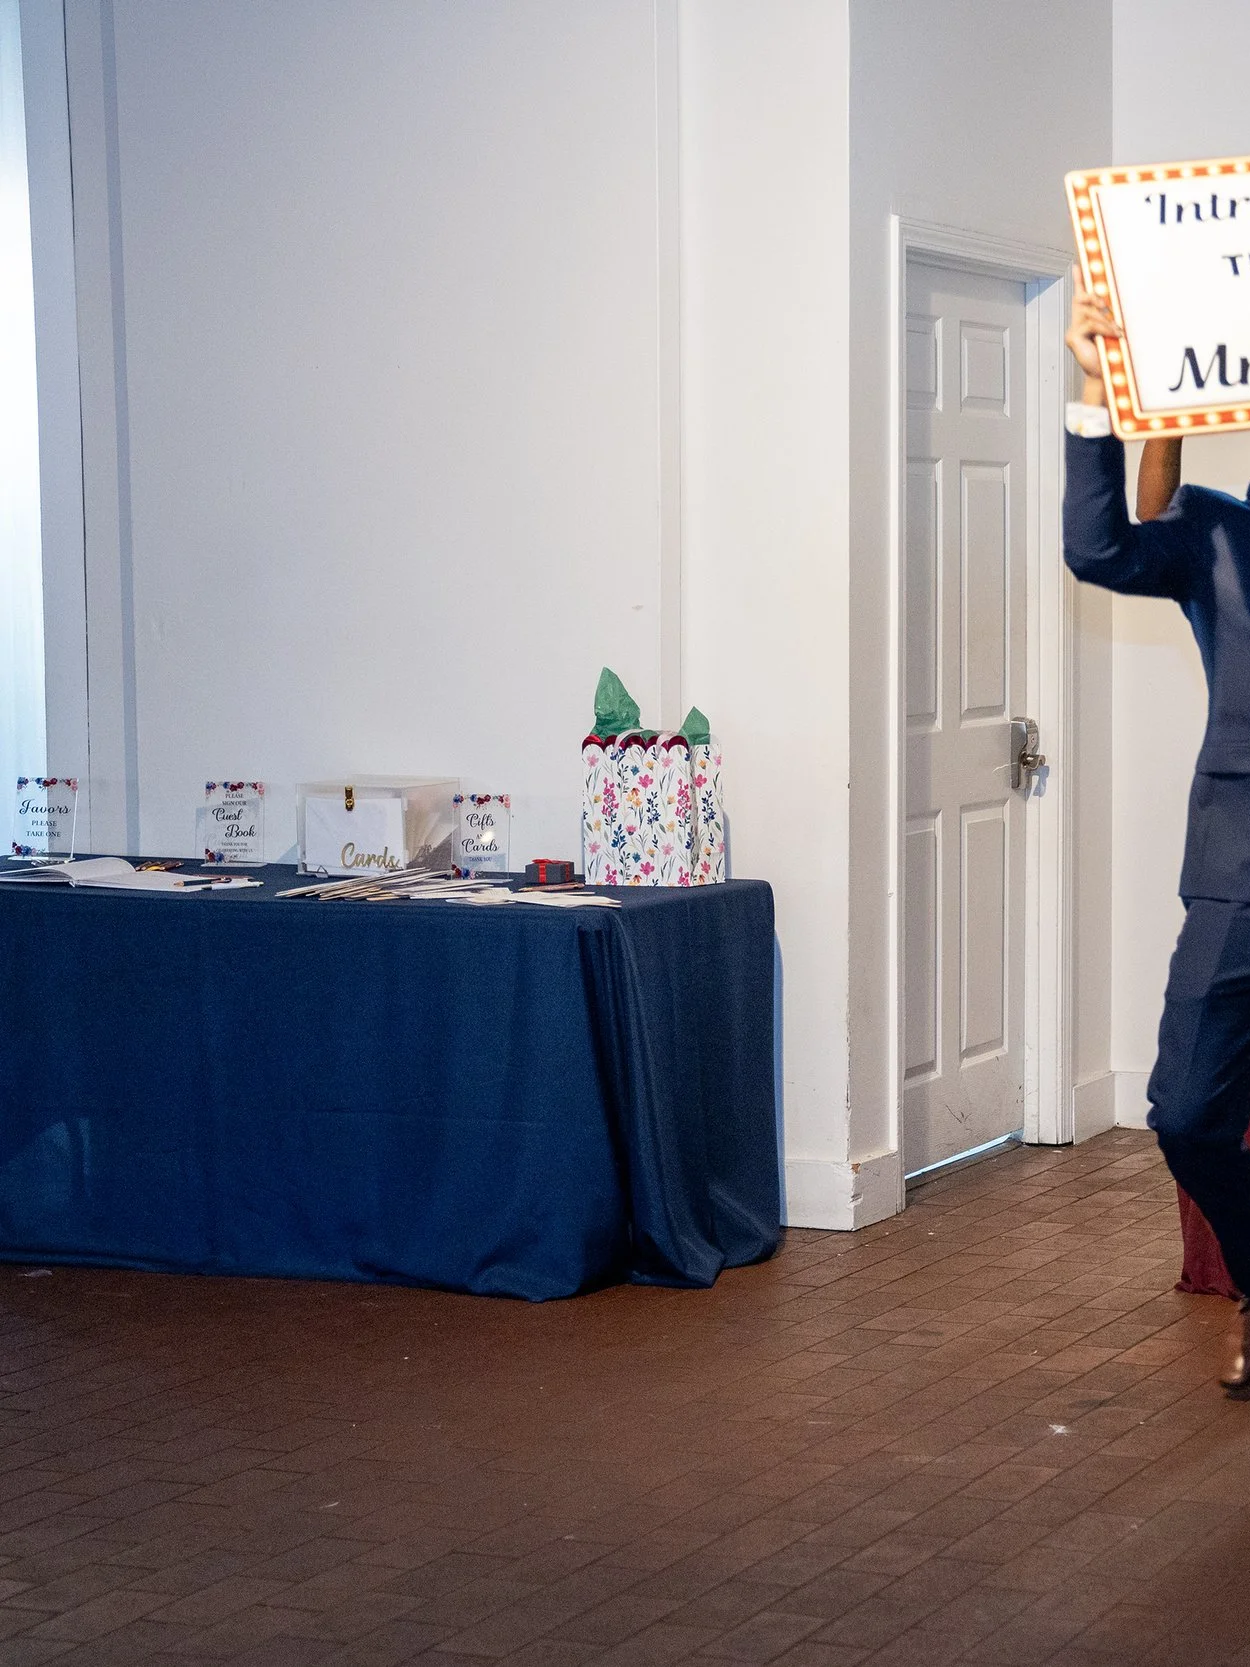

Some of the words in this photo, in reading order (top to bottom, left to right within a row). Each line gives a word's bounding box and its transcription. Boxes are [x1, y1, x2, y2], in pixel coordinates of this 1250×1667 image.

[211, 807, 243, 822] Guest
[466, 813, 496, 831] Gifts
[45, 830, 61, 838] ONE
[224, 824, 257, 838] Book
[461, 838, 500, 854] Cards
[341, 842, 397, 870] Cards
